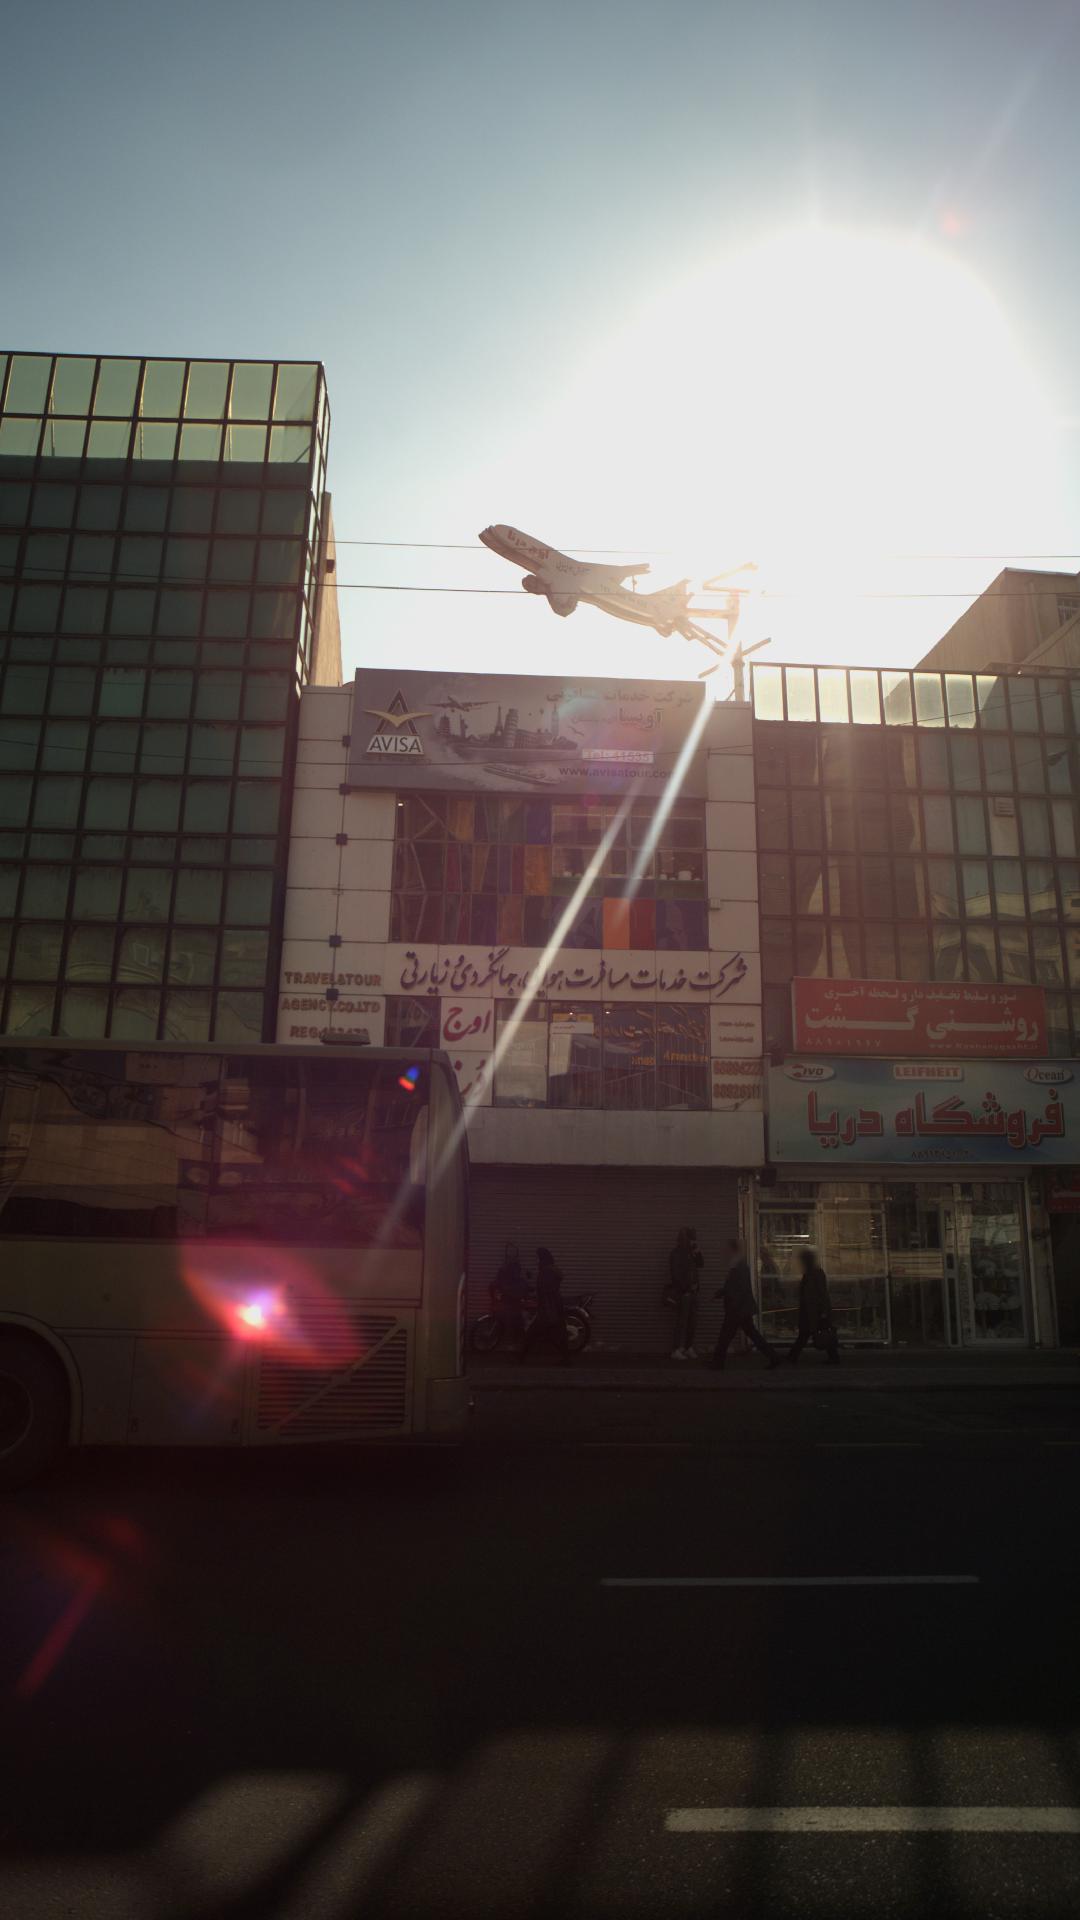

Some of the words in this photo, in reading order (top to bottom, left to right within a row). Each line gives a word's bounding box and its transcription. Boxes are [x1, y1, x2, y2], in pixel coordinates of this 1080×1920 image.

[369, 736, 421, 753] AVISA
[400, 950, 450, 995] زیارتی
[565, 960, 630, 989] مسافرت
[630, 969, 687, 992] خدمات
[689, 952, 748, 998] شرکت
[443, 1006, 492, 1042] اوج
[804, 1000, 920, 1032] گشت
[925, 1005, 1039, 1042] روشنی
[894, 1065, 960, 1078] LEIFHEIT
[806, 1090, 884, 1148] دریا
[895, 1087, 1065, 1149] فروشگاه
